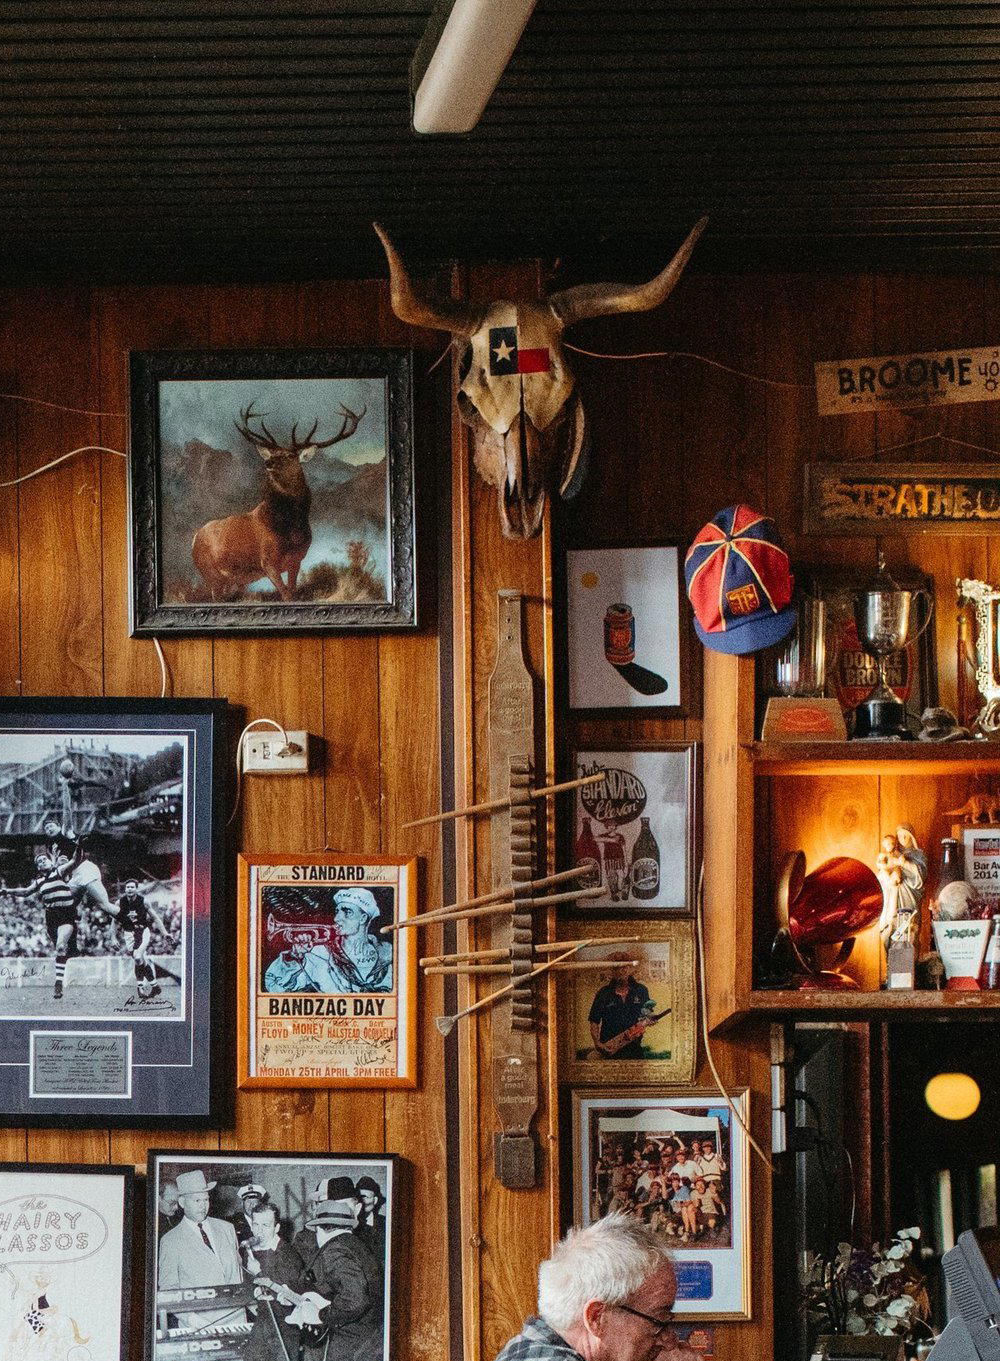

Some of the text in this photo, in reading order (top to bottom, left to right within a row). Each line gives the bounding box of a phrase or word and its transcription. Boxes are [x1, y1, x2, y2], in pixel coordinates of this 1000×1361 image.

[837, 357, 972, 396] BROOME
[973, 861, 990, 870] Bar
[292, 865, 365, 880] STANDARD
[973, 870, 998, 880] 2014
[269, 998, 385, 1016] BANDZAC DAY
[262, 1028, 289, 1039] FLOYD
[292, 1023, 325, 1035] MONEY
[327, 1028, 360, 1039] HALSTEAD
[76, 1039, 117, 1056] Legends
[260, 1067, 396, 1077] MONDAY 25TH APRIL 3PM FREE
